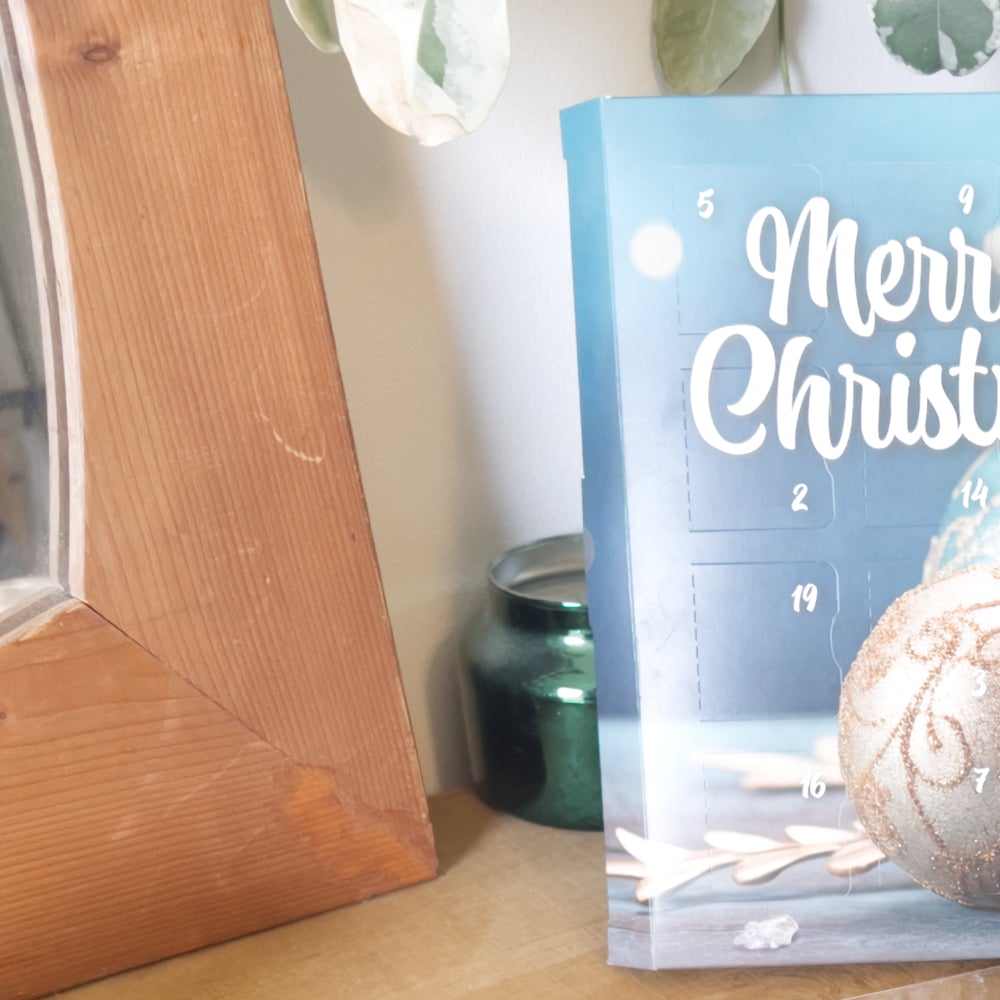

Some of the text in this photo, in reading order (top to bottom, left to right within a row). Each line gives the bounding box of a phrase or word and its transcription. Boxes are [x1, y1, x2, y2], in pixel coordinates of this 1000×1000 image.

[698, 187, 715, 218] 5
[958, 184, 975, 214] 9
[791, 483, 810, 512] 2
[960, 478, 989, 509] 14
[791, 582, 818, 612] 19
[800, 771, 827, 799] 16
[971, 767, 990, 793] 7
